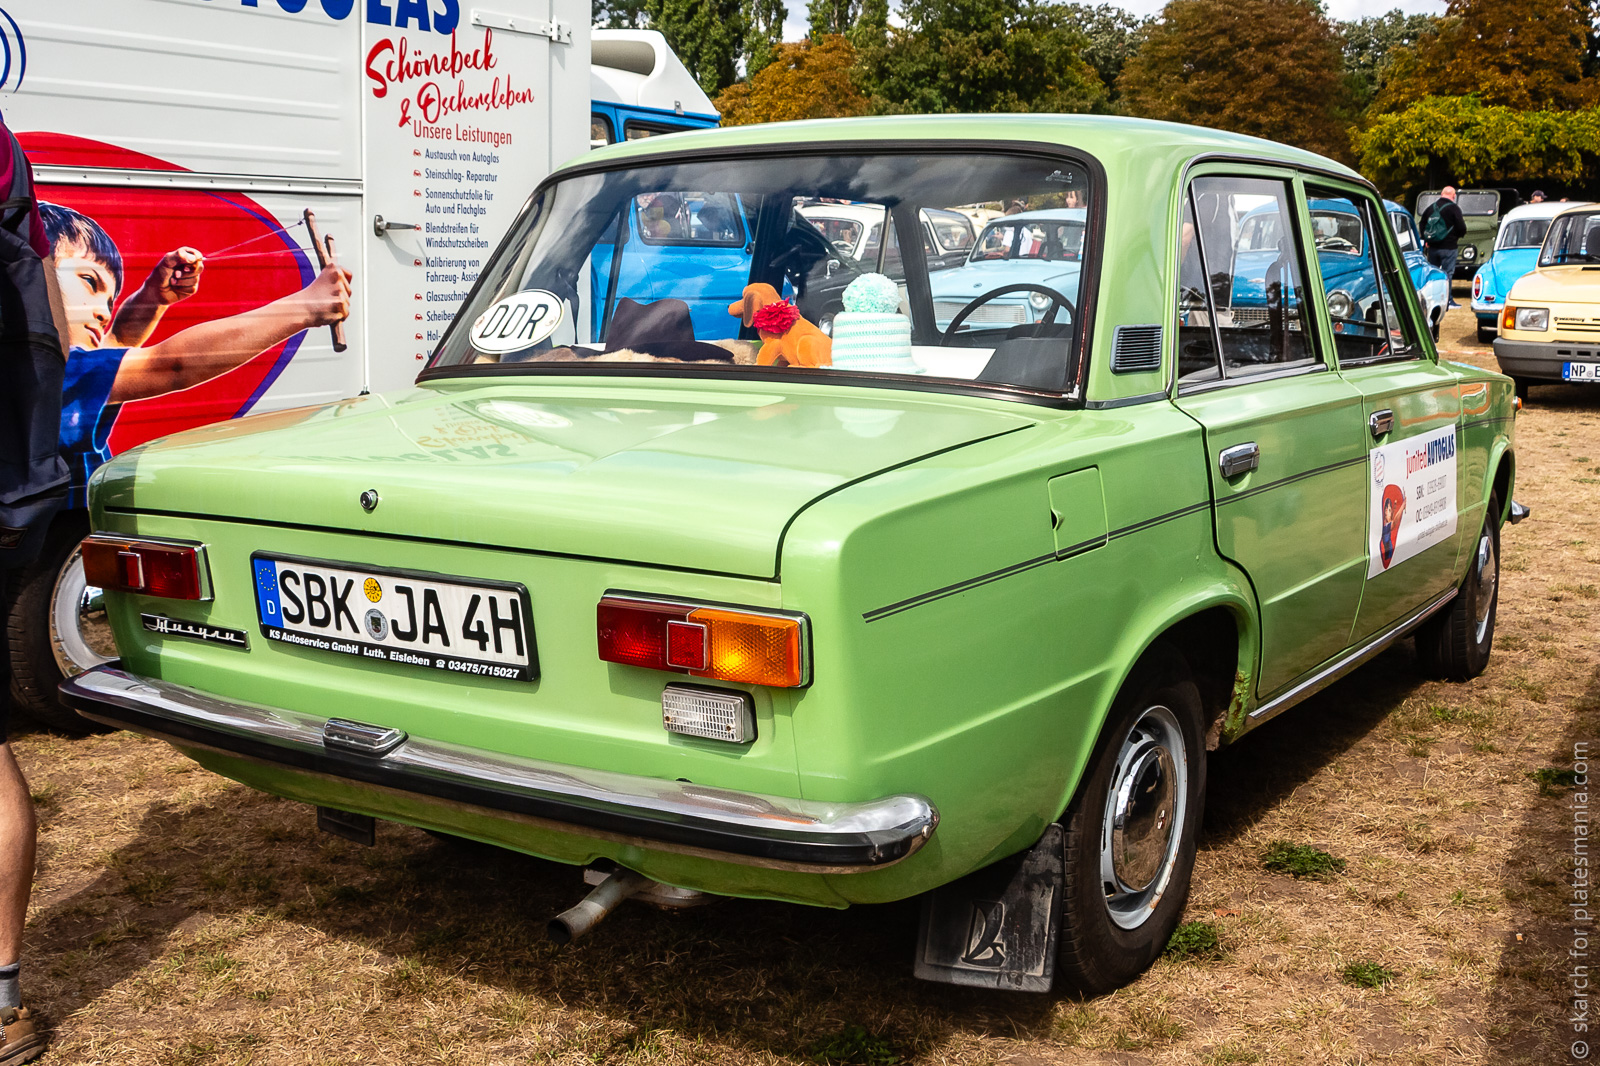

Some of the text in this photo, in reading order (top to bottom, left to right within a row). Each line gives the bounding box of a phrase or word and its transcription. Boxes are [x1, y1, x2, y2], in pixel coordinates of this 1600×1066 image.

[366, 27, 498, 98] Schönebeck
[398, 74, 534, 128] & Oschersleben
[413, 119, 512, 148] Unsere Leistungen
[425, 148, 500, 165] Austausch von Autoglas
[425, 168, 498, 183] Steinschlag- Reparatur
[425, 188, 494, 202] Sonnenschutzfolie für
[425, 203, 487, 216] Auto und Flachglas
[425, 223, 480, 234] Blendstreifen für
[425, 238, 489, 249] Windschutzscheiben
[425, 256, 480, 270] Kalibrierung von
[426, 271, 460, 284] Fahrzeug-
[478, 303, 549, 340] DDR
[1571, 364, 1586, 377] NP
[266, 600, 276, 615] D
[279, 568, 360, 635] SBK
[390, 585, 451, 648] JA
[462, 594, 525, 657] 4H
[269, 629, 520, 680] KS Autoservice GmbH Luth. Eisleben 03475/715027
